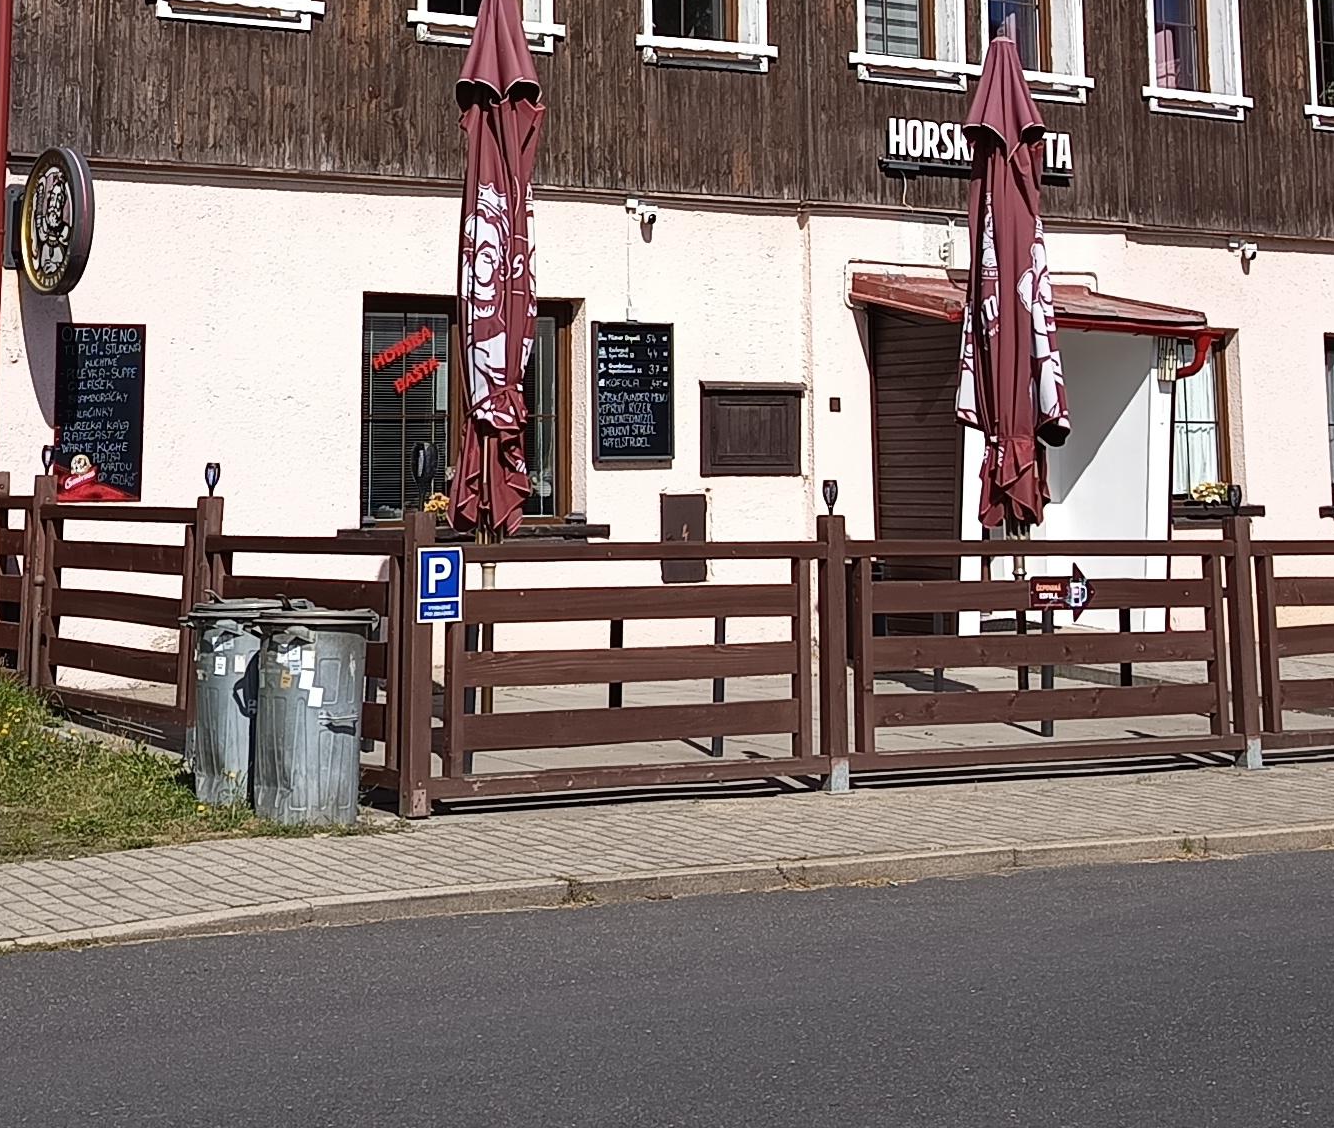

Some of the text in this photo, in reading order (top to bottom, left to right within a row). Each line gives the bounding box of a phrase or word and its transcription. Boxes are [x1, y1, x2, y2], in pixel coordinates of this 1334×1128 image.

[888, 117, 974, 162] HORSK
[606, 378, 640, 388] KOFOLA
[428, 557, 452, 594] P
